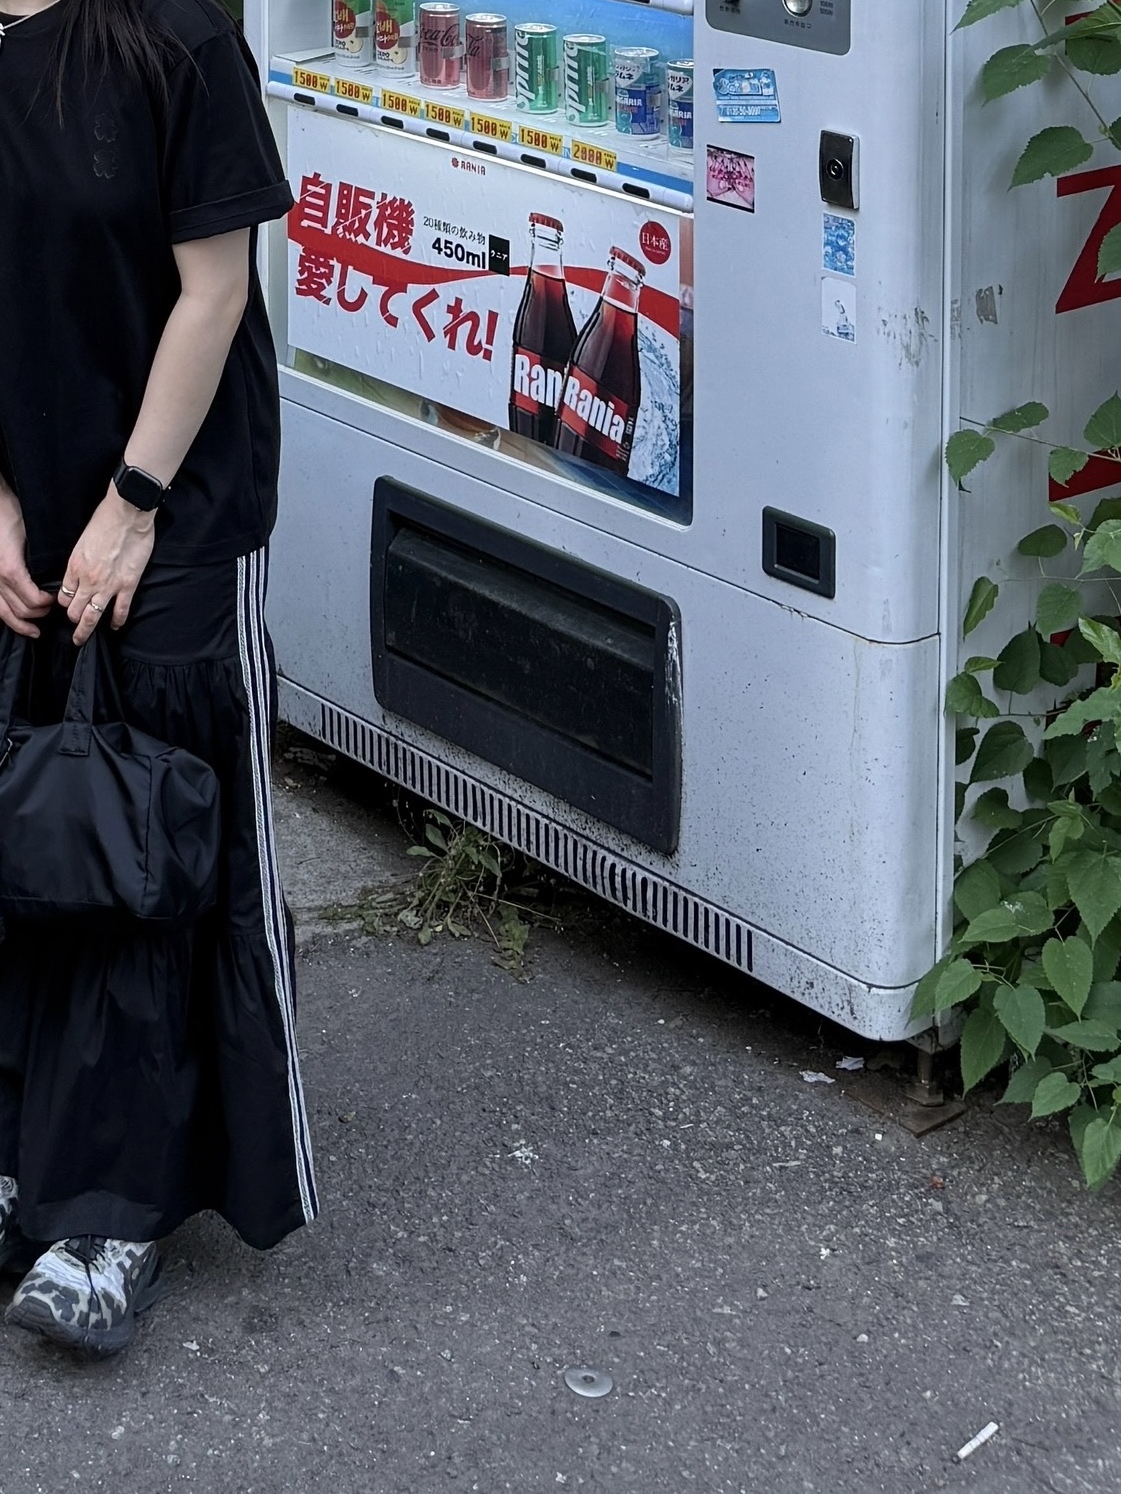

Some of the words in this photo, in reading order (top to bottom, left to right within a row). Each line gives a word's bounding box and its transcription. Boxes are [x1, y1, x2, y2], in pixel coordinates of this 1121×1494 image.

[294, 70, 317, 86] 1500
[335, 80, 360, 97] 1500
[382, 91, 407, 111] 1500
[425, 103, 451, 123] 1500
[470, 116, 497, 134] 1500
[520, 128, 547, 148] 1500
[573, 144, 602, 165] 2000
[297, 172, 415, 255] 自販機
[423, 216, 486, 245] 20種類の飲み物
[642, 232, 668, 251] 日本産
[432, 237, 486, 269] 450ml
[563, 375, 626, 444] Rania
